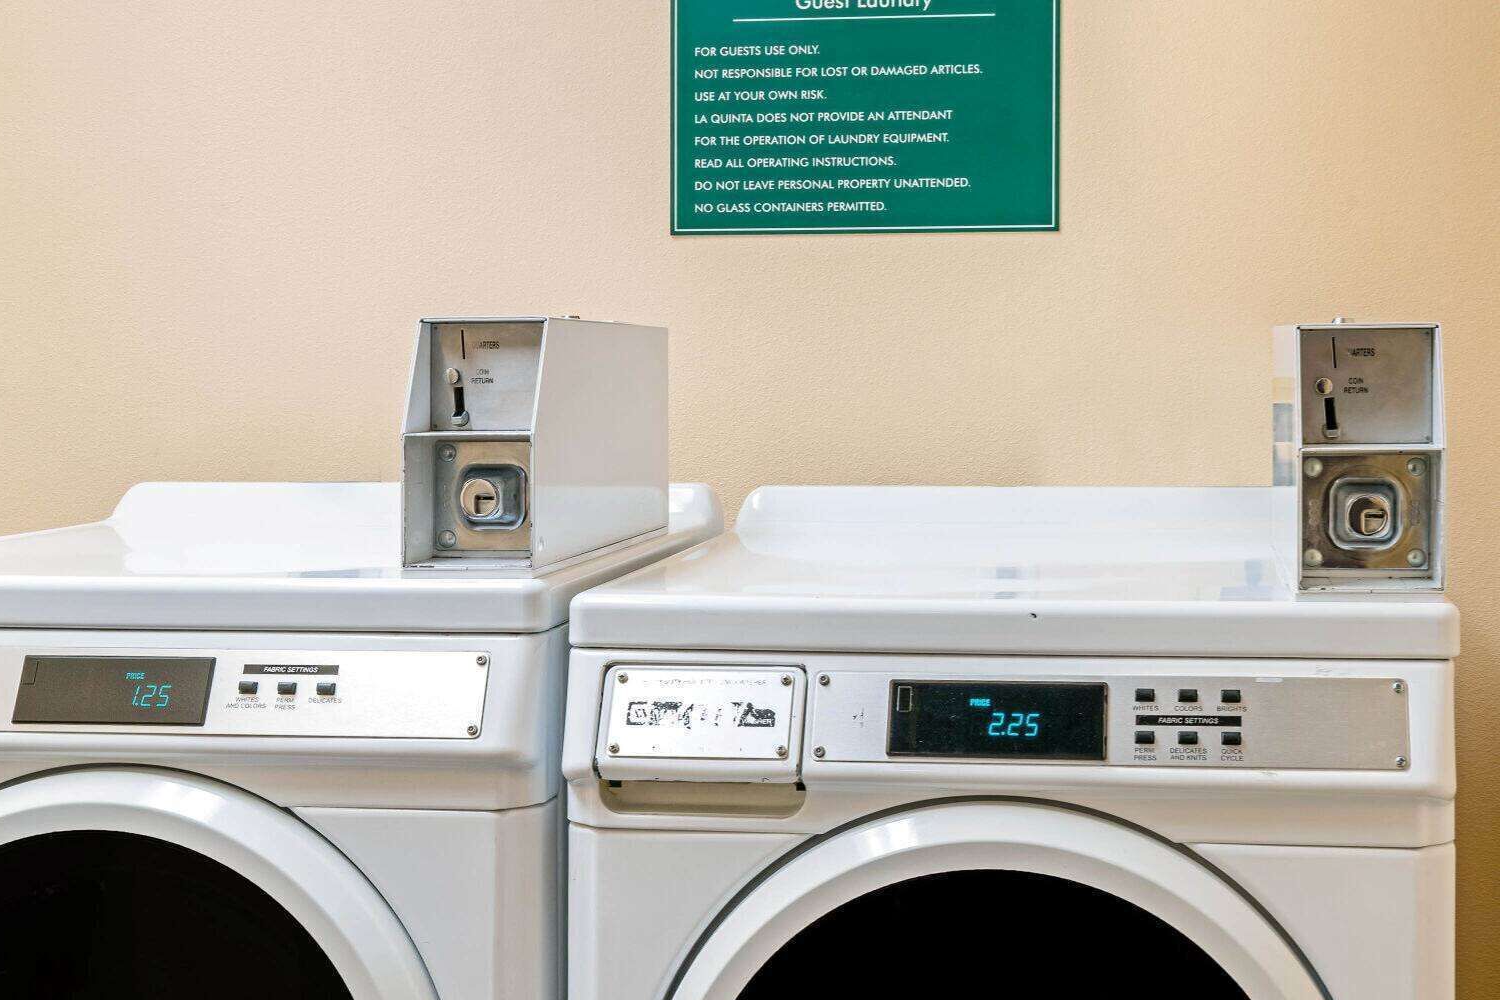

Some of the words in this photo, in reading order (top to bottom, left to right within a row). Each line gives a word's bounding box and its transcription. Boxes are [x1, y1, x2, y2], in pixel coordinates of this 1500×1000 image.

[795, 0, 849, 9] Guest
[857, 0, 931, 11] Laundry
[694, 47, 717, 56] FOR
[719, 46, 761, 56] GUESTS
[764, 45, 785, 55] USE
[788, 44, 820, 55] ONLY.
[694, 69, 718, 79] NOT
[721, 68, 792, 78] RESPONSIBLE
[795, 67, 818, 77] FOR
[821, 67, 848, 77] LOST
[851, 66, 867, 76] OR
[870, 65, 928, 75] DAMAGED
[930, 64, 983, 75] ARTICLES.
[694, 91, 715, 101] USE
[717, 91, 732, 101] AT
[733, 90, 765, 101] YOUR
[768, 90, 797, 100] OWN
[800, 89, 827, 100] RISK.
[694, 114, 708, 124] LA
[710, 113, 754, 124] QUINTA
[756, 113, 787, 123] DOES
[789, 112, 815, 122] NOT
[817, 112, 864, 122] PROVIDE
[867, 111, 884, 121] AN
[887, 110, 953, 121] ATTENDANT
[694, 136, 717, 146] FOR
[719, 136, 740, 145] THE
[743, 135, 806, 145] OPERATION
[808, 134, 824, 144] OF
[828, 134, 880, 144] LAUNDRY
[883, 132, 949, 143] EQUIPMENT.
[694, 159, 722, 168] READ
[725, 158, 744, 168] ALL
[747, 157, 809, 168] OPERATING
[812, 156, 897, 167] INSTRUCTIONS.
[694, 181, 713, 190] DO
[715, 180, 740, 190] NOT
[743, 180, 775, 190] LEAVE
[777, 179, 834, 189] PERSONAL
[837, 178, 891, 189] PROPERTY
[893, 177, 971, 188] UNATTENDED.
[694, 203, 713, 213] NO
[716, 203, 750, 213] GLASS
[753, 202, 824, 212] CONTAINERS
[827, 201, 888, 211] PERMITTED.
[472, 341, 500, 350] ARTERS
[1347, 347, 1375, 357] ARTERS
[1348, 377, 1364, 385] COIN
[1343, 386, 1369, 394] RETURN
[125, 672, 146, 680] PRICE
[131, 684, 172, 707] 1.25
[969, 698, 991, 707] PRICE
[988, 712, 1040, 737] 2.25
